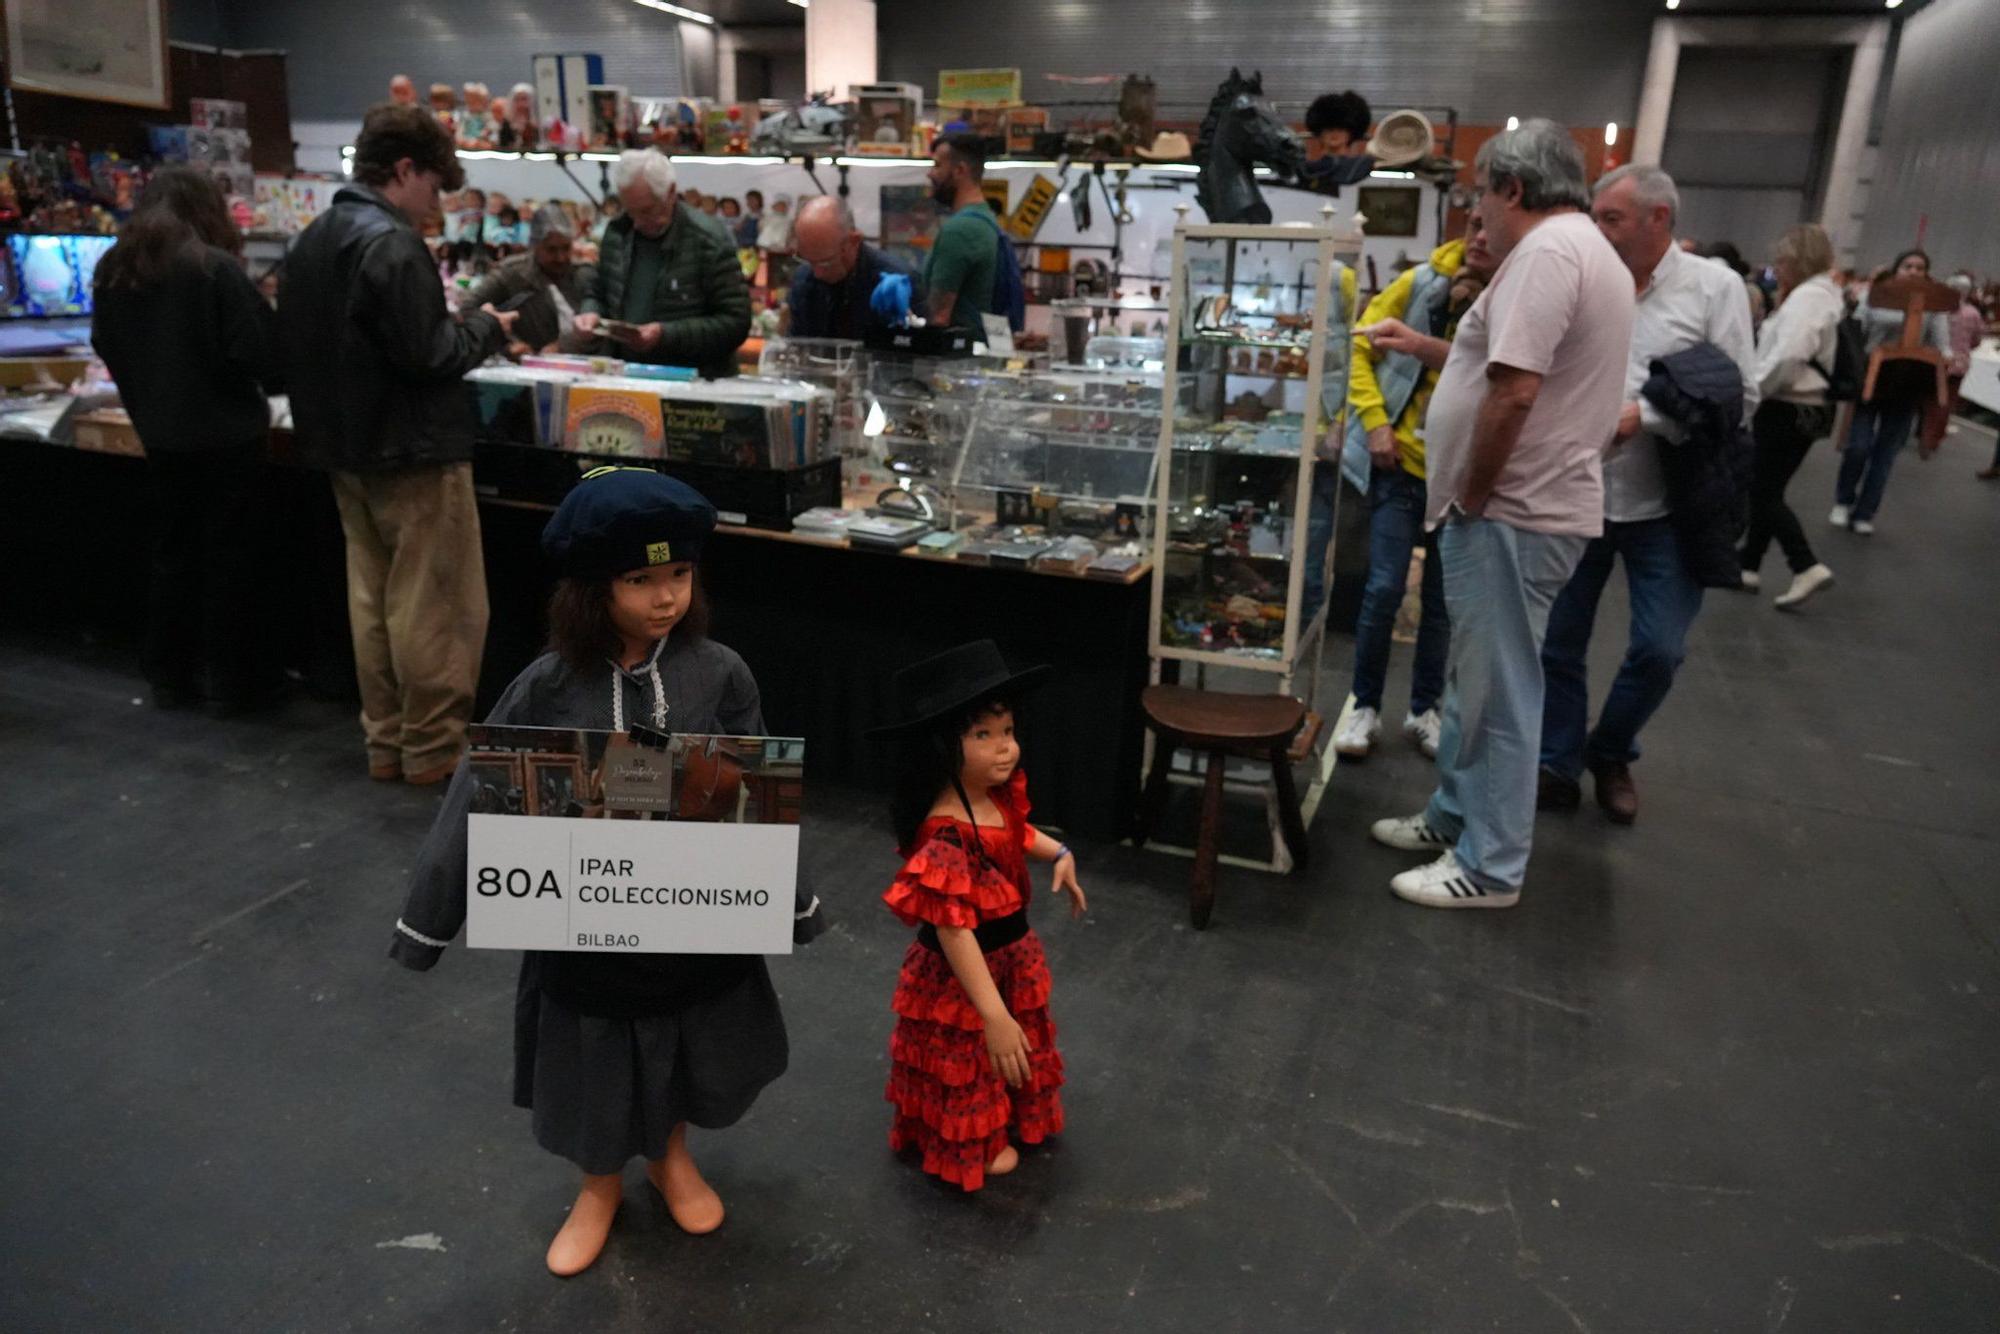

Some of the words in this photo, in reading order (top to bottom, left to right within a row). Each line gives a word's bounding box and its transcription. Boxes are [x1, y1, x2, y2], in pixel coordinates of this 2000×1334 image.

[1018, 187, 1050, 227] TAXI
[580, 858, 634, 877] IPAR
[476, 866, 563, 900] 80A
[578, 885, 769, 907] COLECCIONISMO
[577, 933, 640, 948] BILBAO
